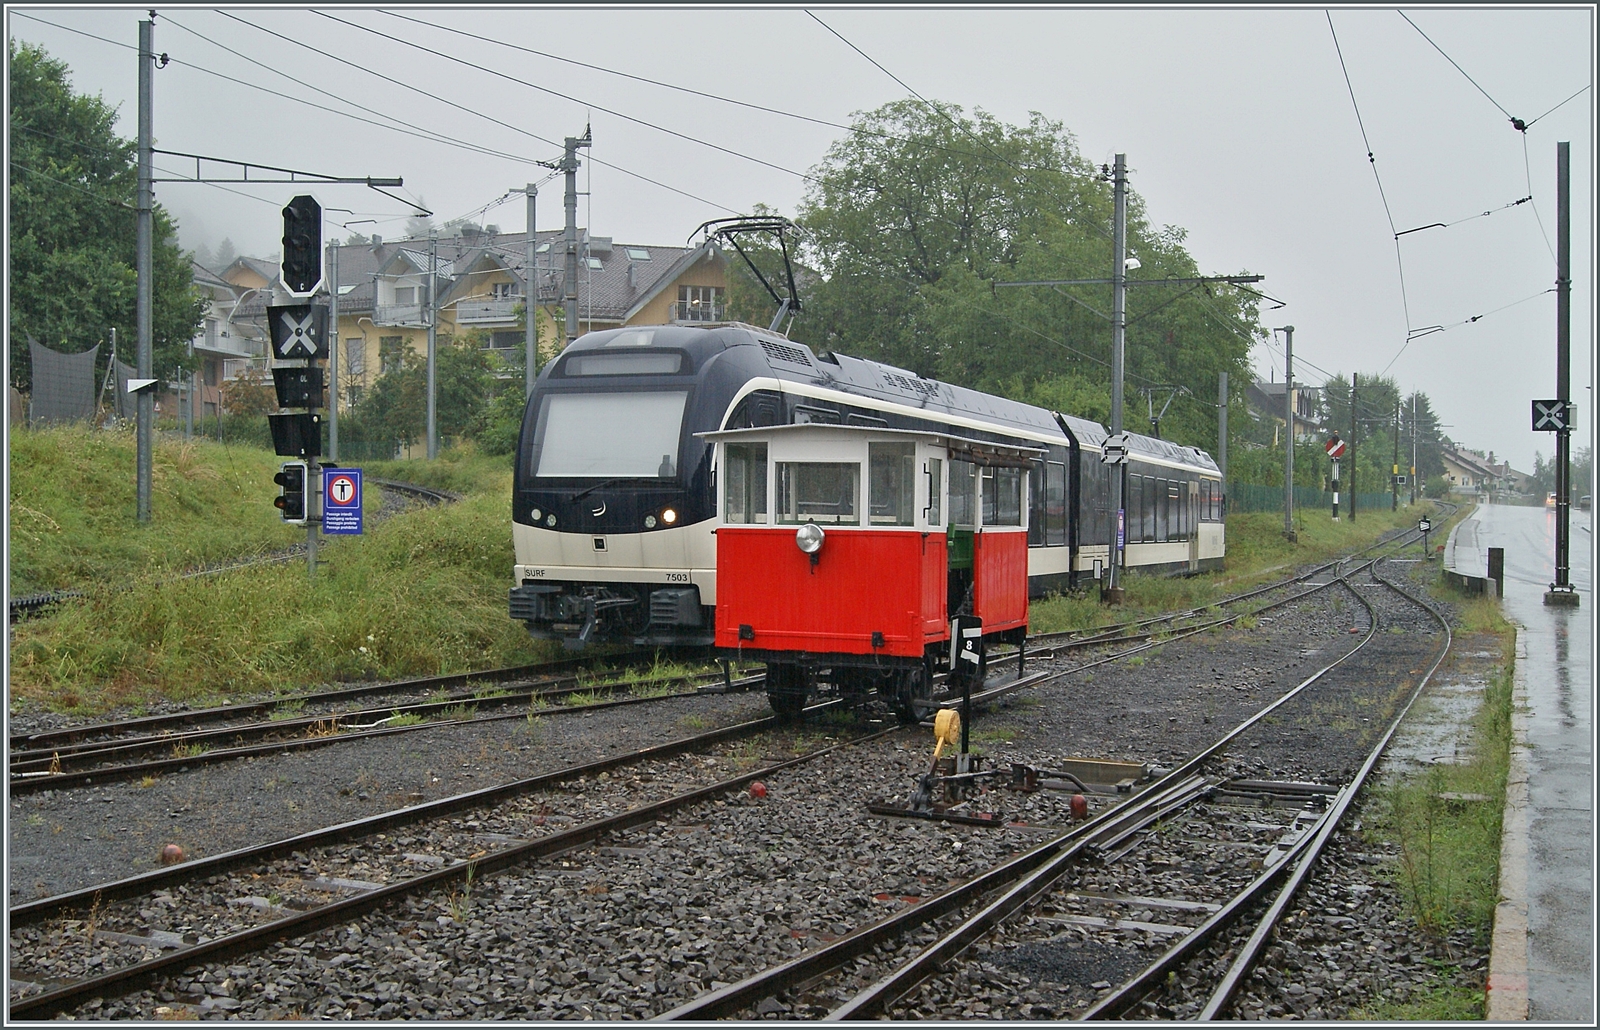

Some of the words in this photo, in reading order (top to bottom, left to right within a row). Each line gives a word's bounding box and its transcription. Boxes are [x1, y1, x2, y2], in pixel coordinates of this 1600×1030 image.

[300, 282, 305, 291] C
[525, 568, 545, 577] SURF
[665, 573, 688, 582] 7503
[966, 640, 973, 650] 8
